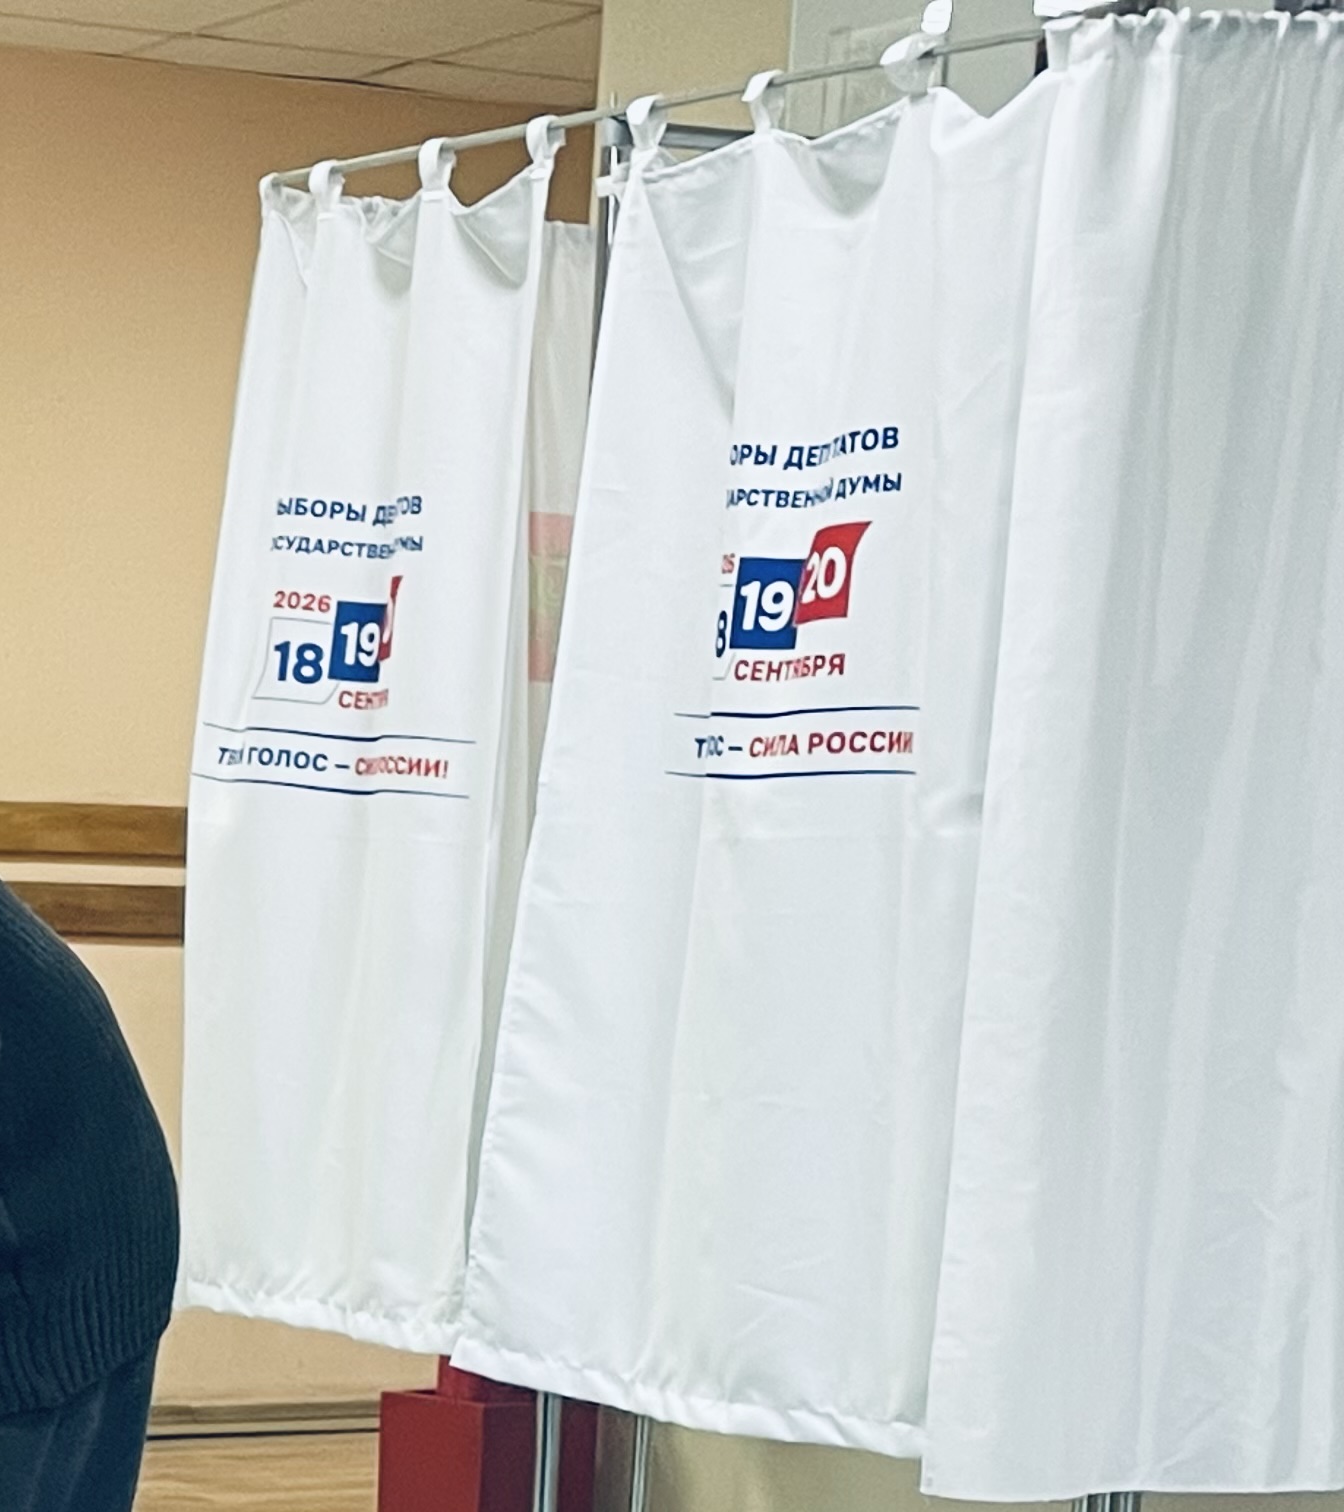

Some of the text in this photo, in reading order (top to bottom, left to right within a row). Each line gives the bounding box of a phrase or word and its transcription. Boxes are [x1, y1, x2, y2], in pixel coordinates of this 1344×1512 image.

[277, 497, 368, 523] ЫБОРЫ
[273, 590, 332, 613] 2026
[739, 580, 795, 633] 19
[801, 546, 848, 605] 20
[274, 621, 381, 685] 18 19
[247, 745, 329, 773] ГОЛОС
[749, 733, 800, 758] СИЛА
